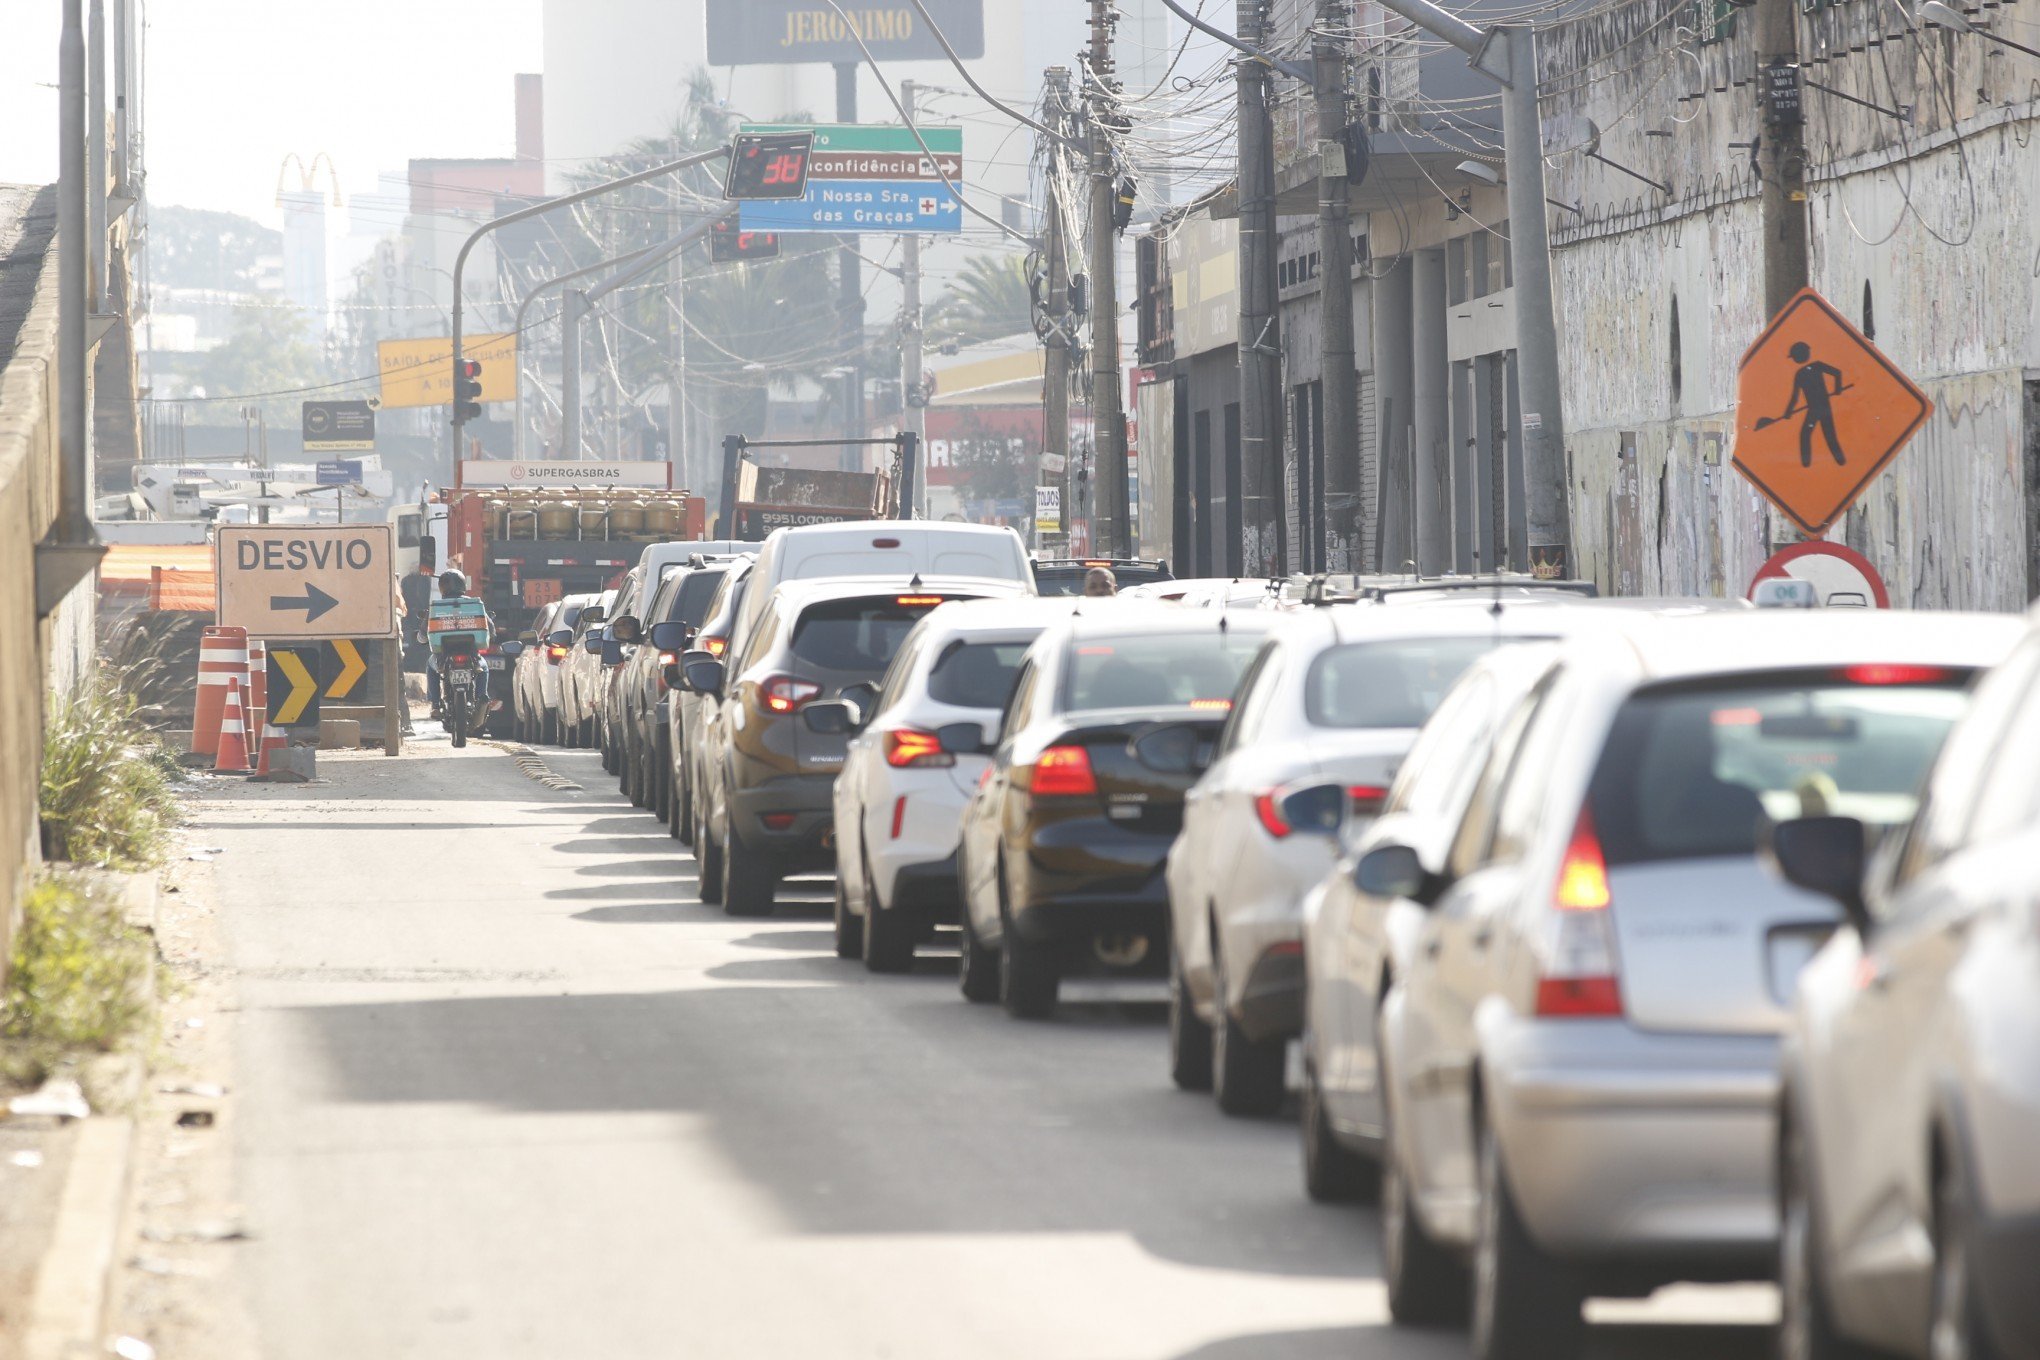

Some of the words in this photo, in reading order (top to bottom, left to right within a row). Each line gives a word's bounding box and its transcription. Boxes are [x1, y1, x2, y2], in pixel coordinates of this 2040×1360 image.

[808, 157, 916, 173] confidência
[823, 190, 877, 203] Nossa
[881, 190, 914, 203] Sra.
[813, 209, 843, 222] das
[853, 209, 914, 225] Graças
[528, 467, 620, 478] SUPERGASBRAS
[1037, 490, 1060, 507] TOLDOS
[237, 538, 372, 571] DESVIO
